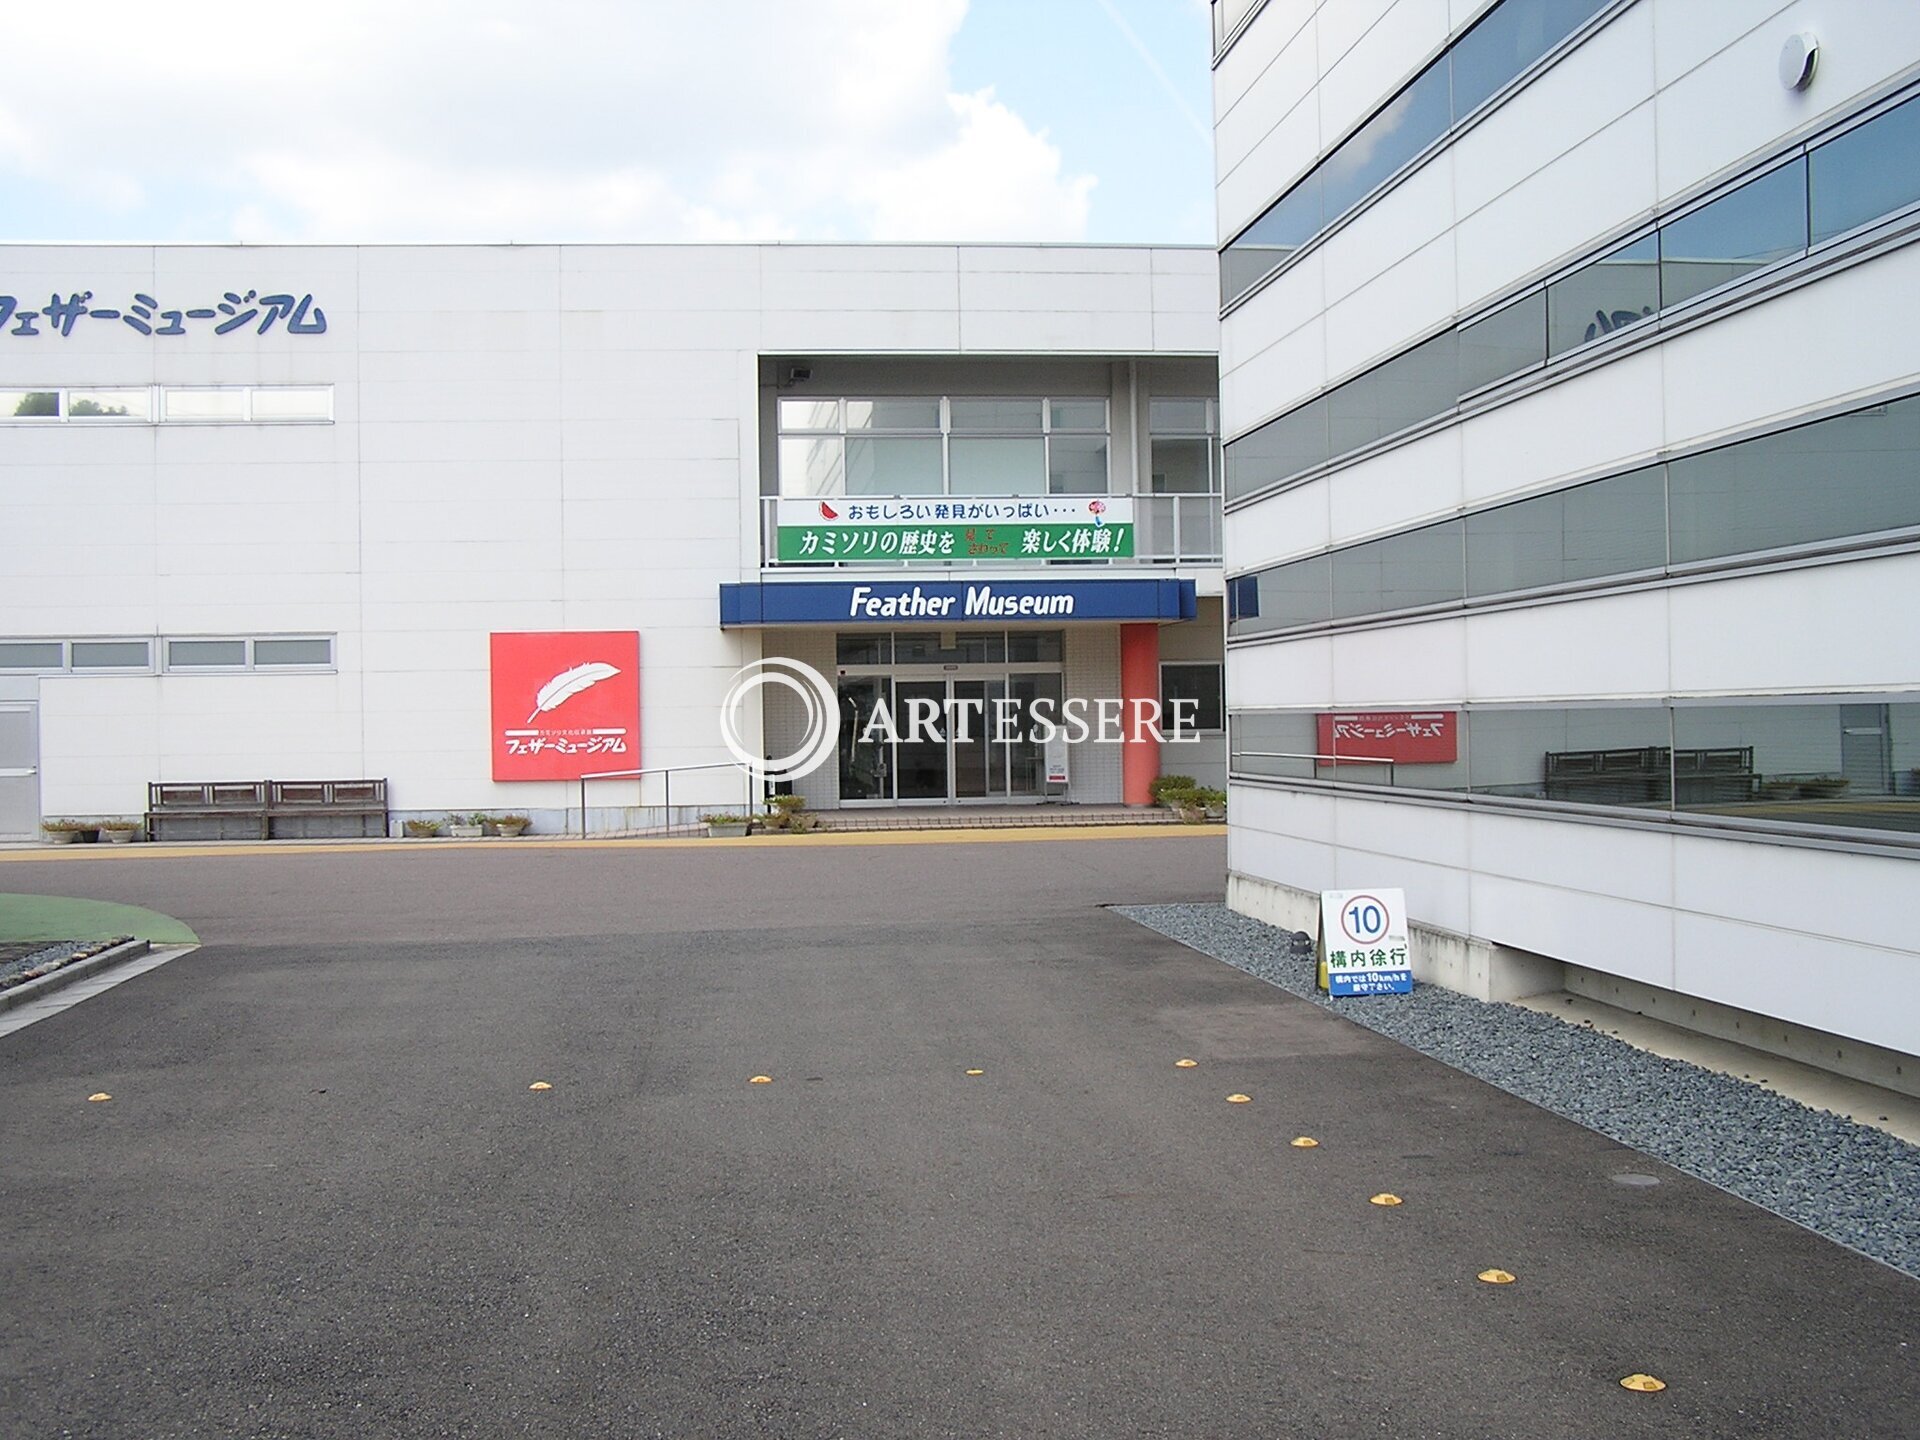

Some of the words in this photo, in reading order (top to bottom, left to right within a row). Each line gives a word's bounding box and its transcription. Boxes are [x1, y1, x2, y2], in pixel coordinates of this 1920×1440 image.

[799, 529, 955, 555] カミソリの歴史を
[850, 586, 956, 617] Feather
[964, 586, 1075, 616] Museum
[505, 736, 627, 754] フェザーミュージアム
[1348, 905, 1381, 934] 10
[1330, 948, 1406, 968] 構内徐行
